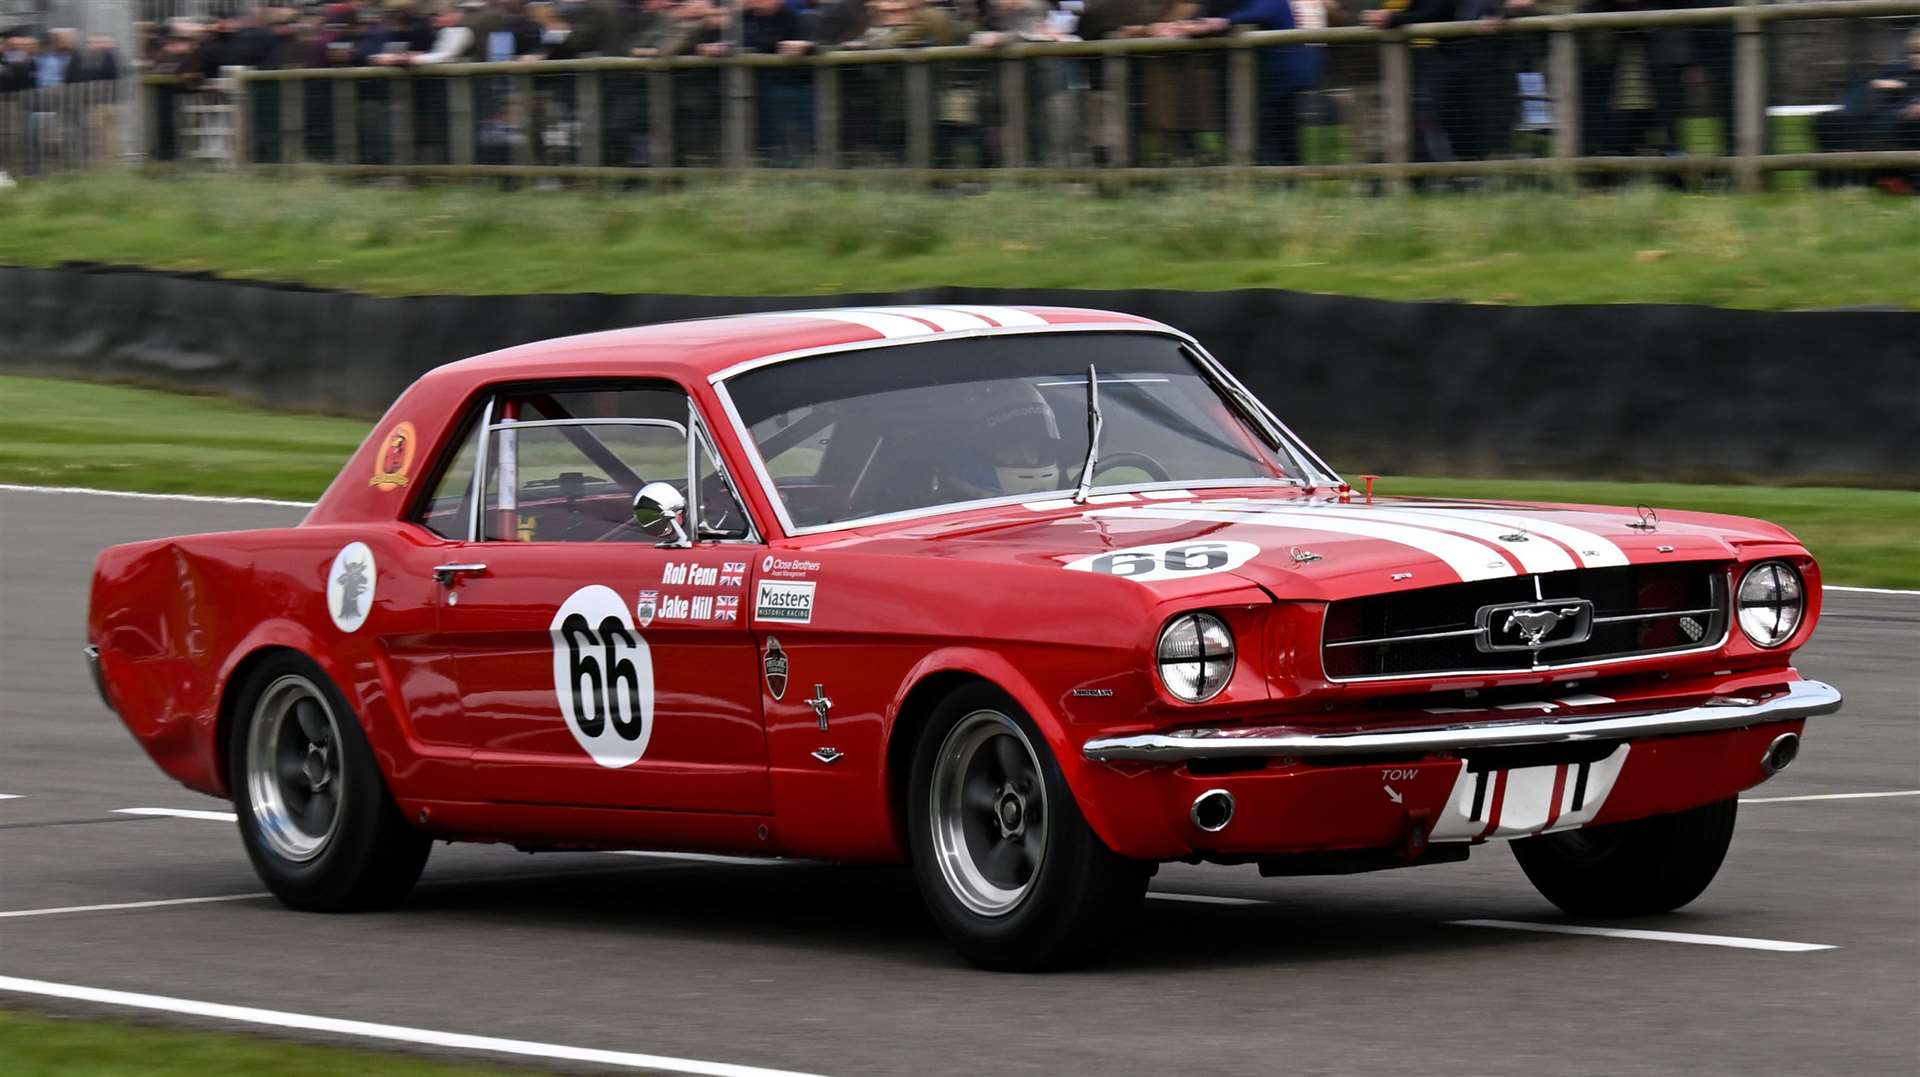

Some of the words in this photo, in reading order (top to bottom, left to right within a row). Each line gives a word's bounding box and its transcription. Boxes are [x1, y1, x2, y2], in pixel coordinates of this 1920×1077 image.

[773, 559, 793, 570] Close
[792, 559, 821, 571] Brothers
[1092, 543, 1228, 577] 66
[662, 562, 688, 585] Rob
[687, 563, 718, 586] Fenn
[658, 595, 689, 619] Jake
[690, 596, 713, 620] Hill
[760, 586, 811, 607] Masters
[758, 609, 785, 617] HISTORIC
[786, 610, 809, 618] RACING
[561, 613, 643, 741] 66
[1381, 768, 1419, 781] TOW
